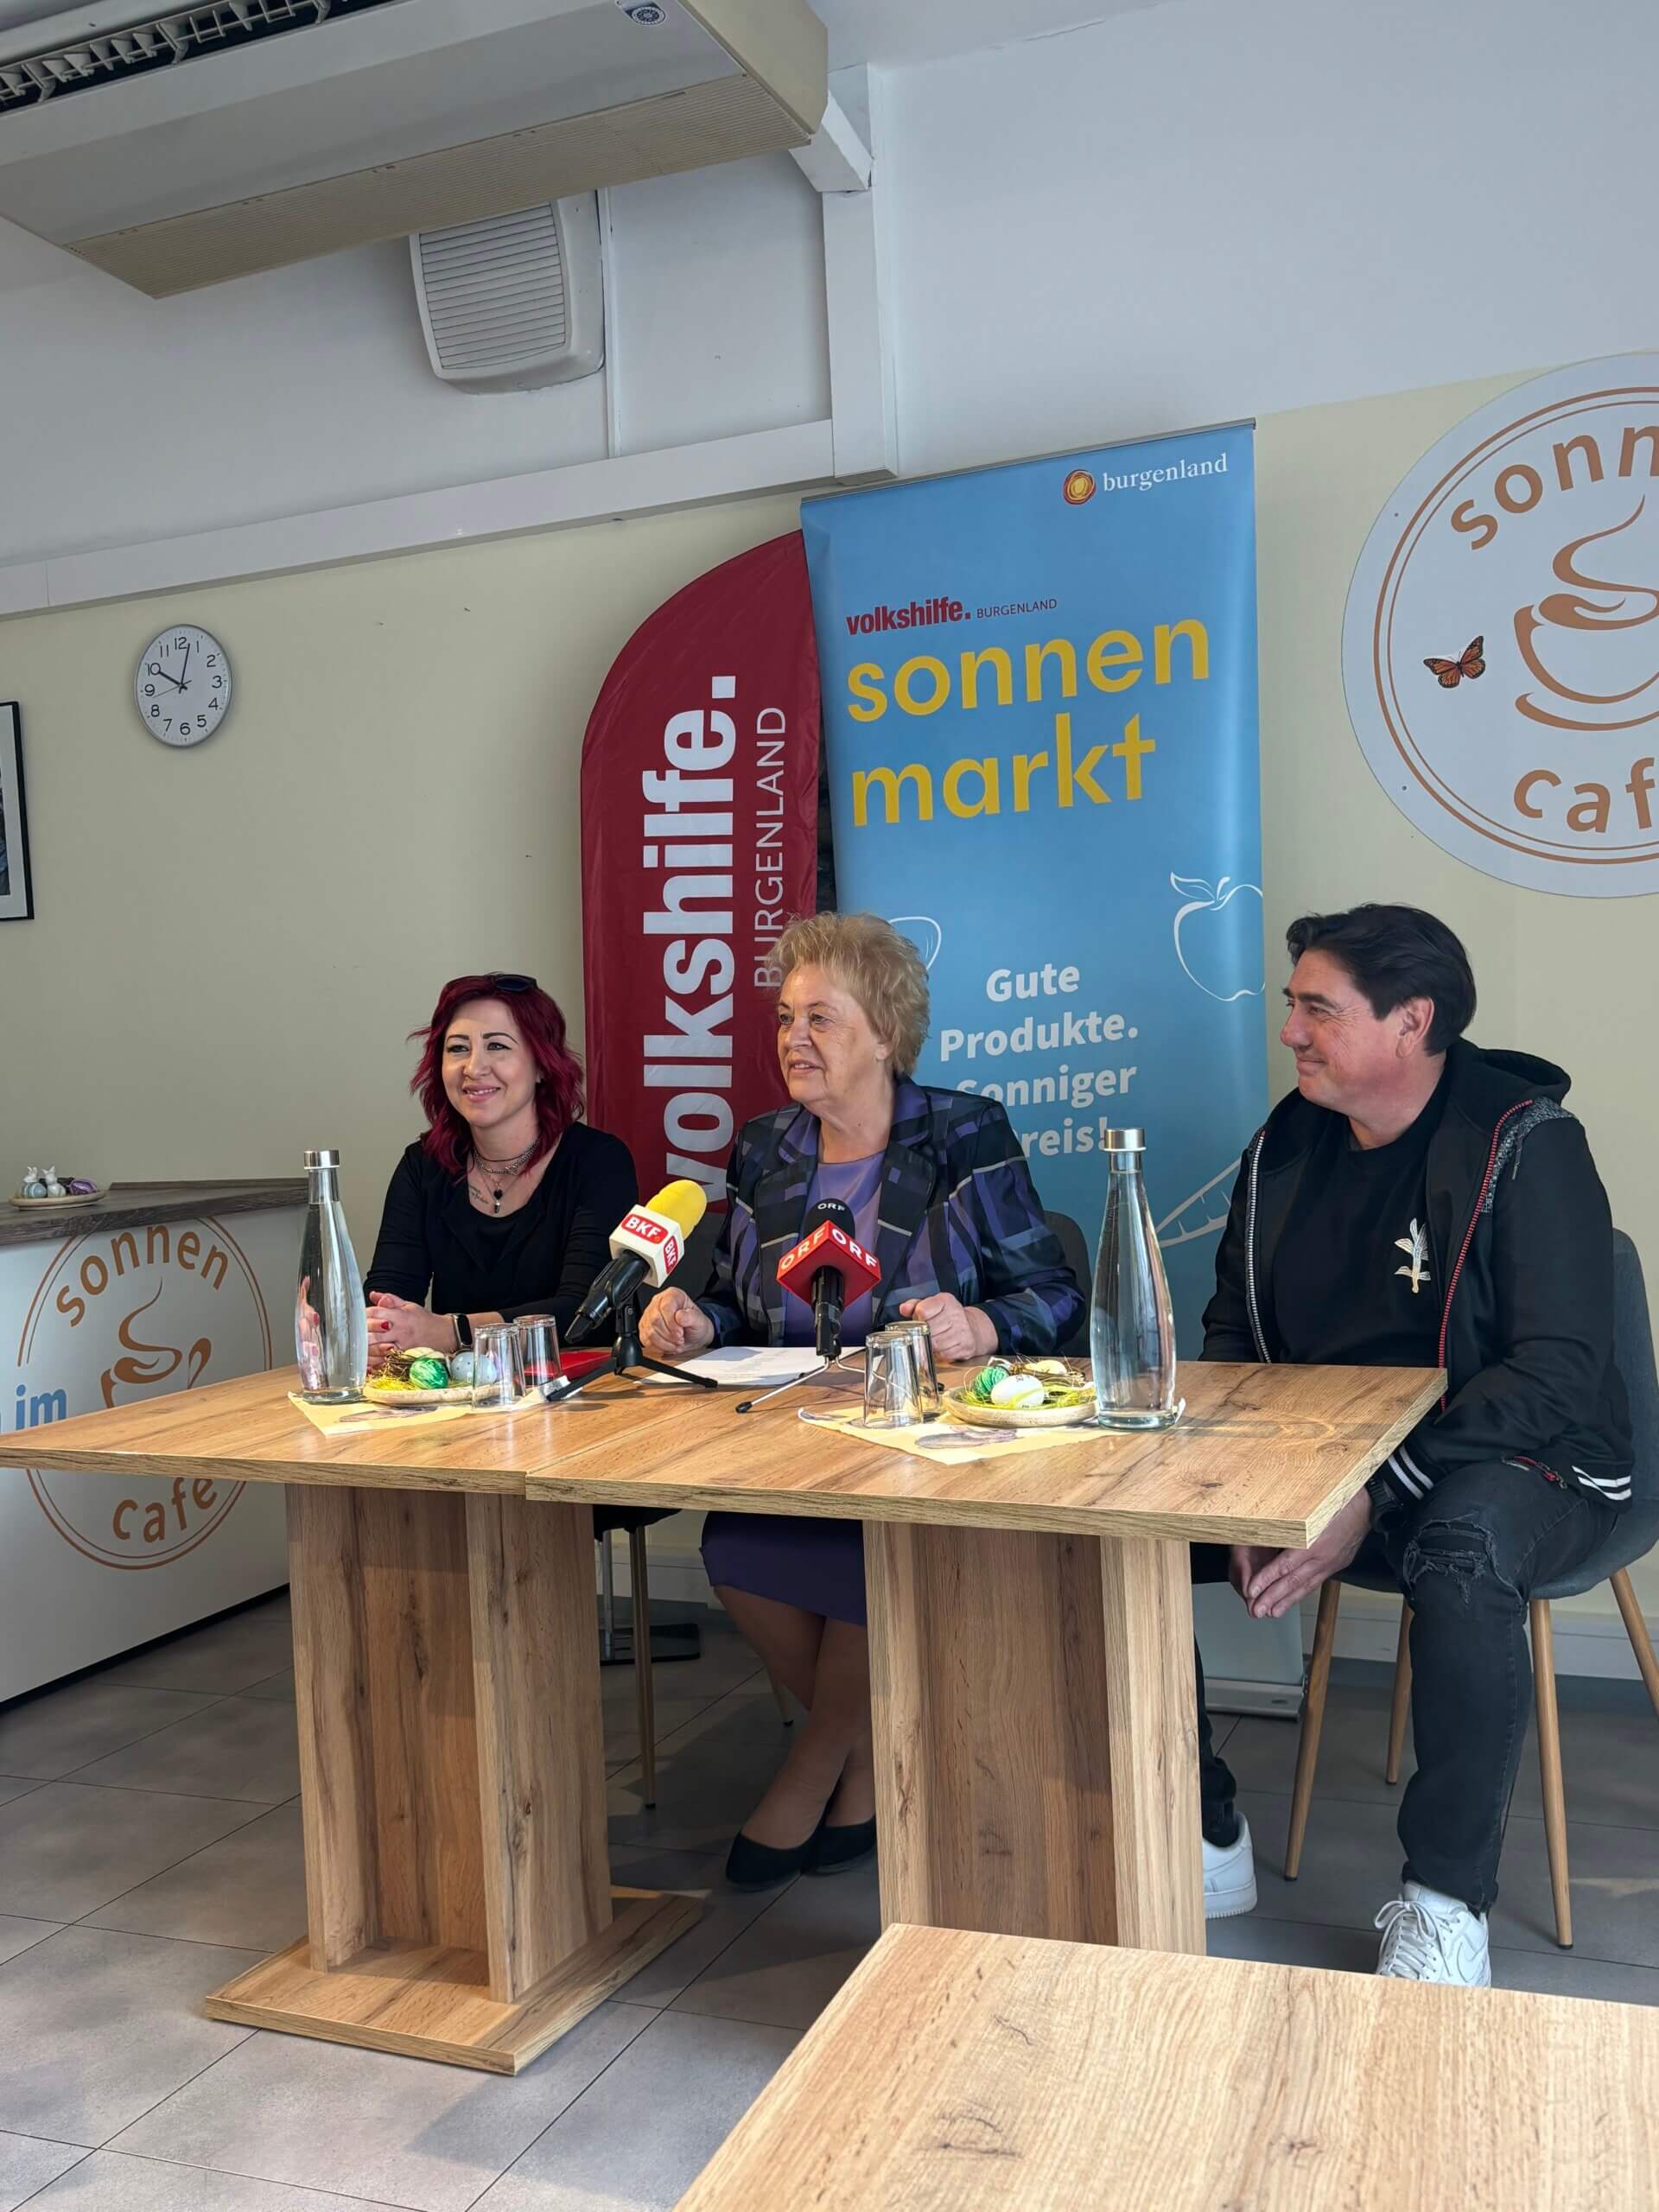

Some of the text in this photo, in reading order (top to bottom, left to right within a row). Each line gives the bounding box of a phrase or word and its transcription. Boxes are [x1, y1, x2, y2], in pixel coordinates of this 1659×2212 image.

[1103, 454, 1228, 493] burgenland
[846, 596, 1058, 635] volkshilfe. BURGENLAND
[161, 644, 169, 658] 11
[175, 637, 188, 650] 12
[147, 662, 161, 676] 10
[207, 654, 216, 667] 2
[847, 619, 1210, 722] sonnen
[144, 683, 156, 696] 9
[212, 675, 222, 689] 3
[150, 704, 160, 717] 8
[208, 697, 219, 710] 4
[163, 719, 172, 732] 7
[180, 722, 190, 735] 6
[197, 715, 207, 727] 5
[852, 712, 1156, 827] markt
[754, 707, 785, 987] BURGENLAND
[642, 676, 736, 1203] volkshilfe.
[986, 963, 1080, 1002] Gute
[940, 1010, 1139, 1062] Produkte.
[1014, 1116, 1108, 1158] reis!
[817, 1202, 846, 1211] ORF
[780, 1227, 826, 1270] ORF
[831, 1229, 878, 1268] ORF
[56, 1225, 229, 1327] sonnen
